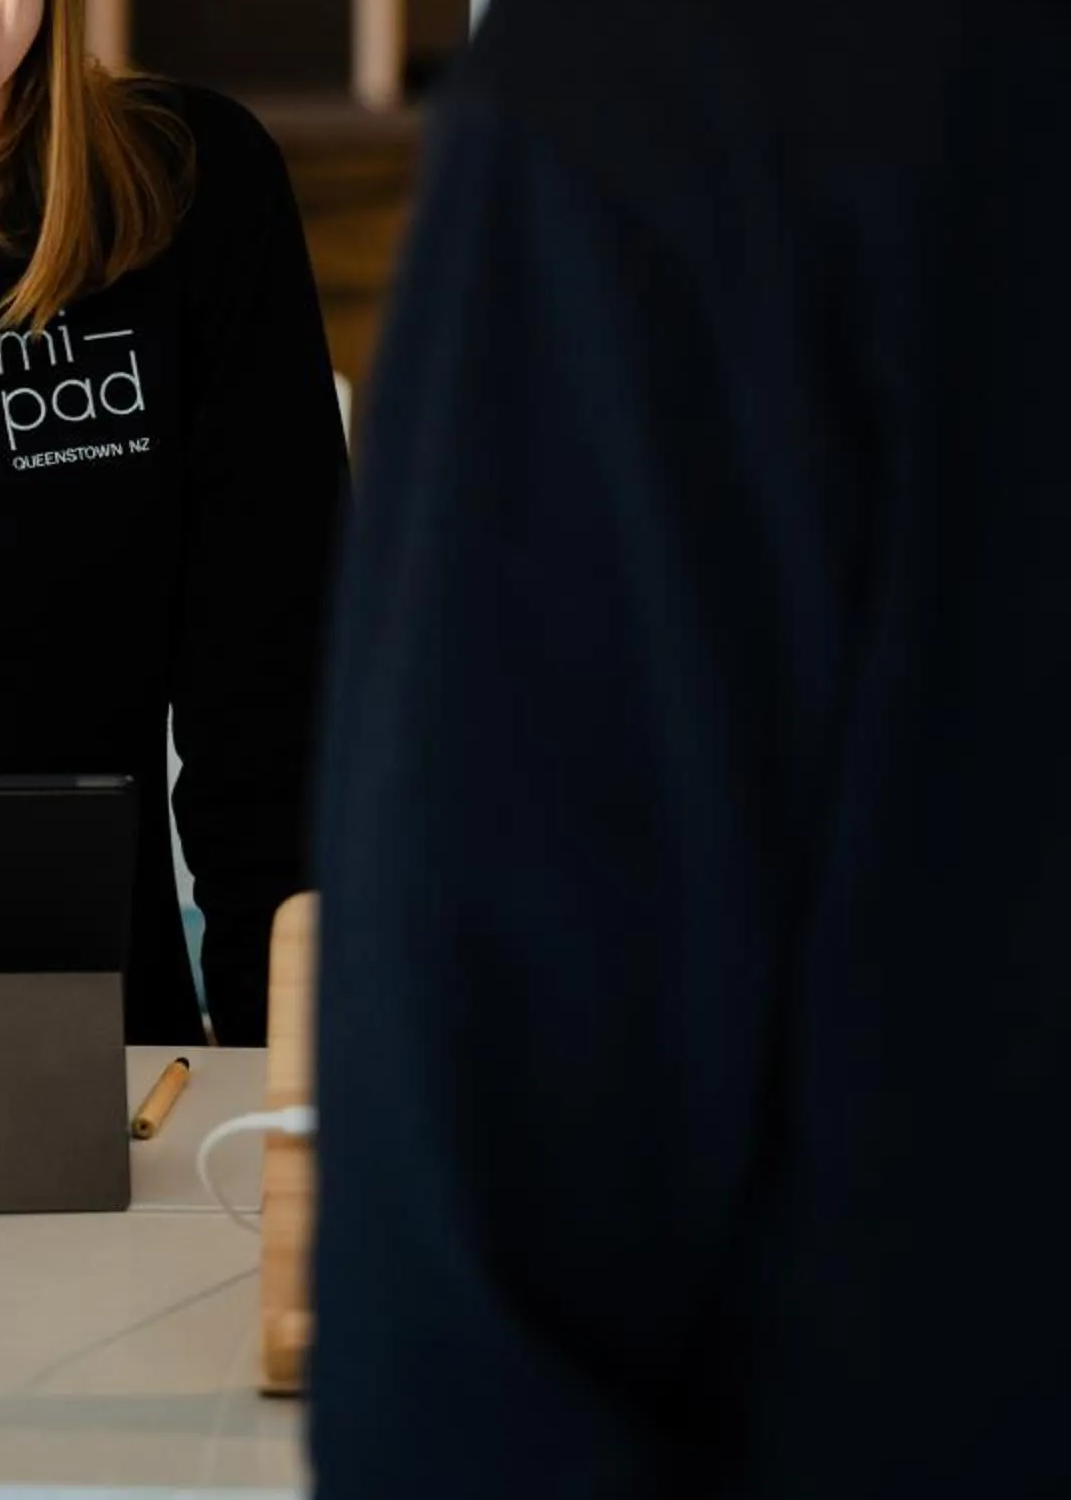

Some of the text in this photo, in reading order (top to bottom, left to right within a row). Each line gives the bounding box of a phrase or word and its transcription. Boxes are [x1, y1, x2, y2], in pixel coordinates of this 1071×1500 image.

[1, 350, 145, 451] pad
[12, 437, 150, 471] QUEENSTOWN NZ
